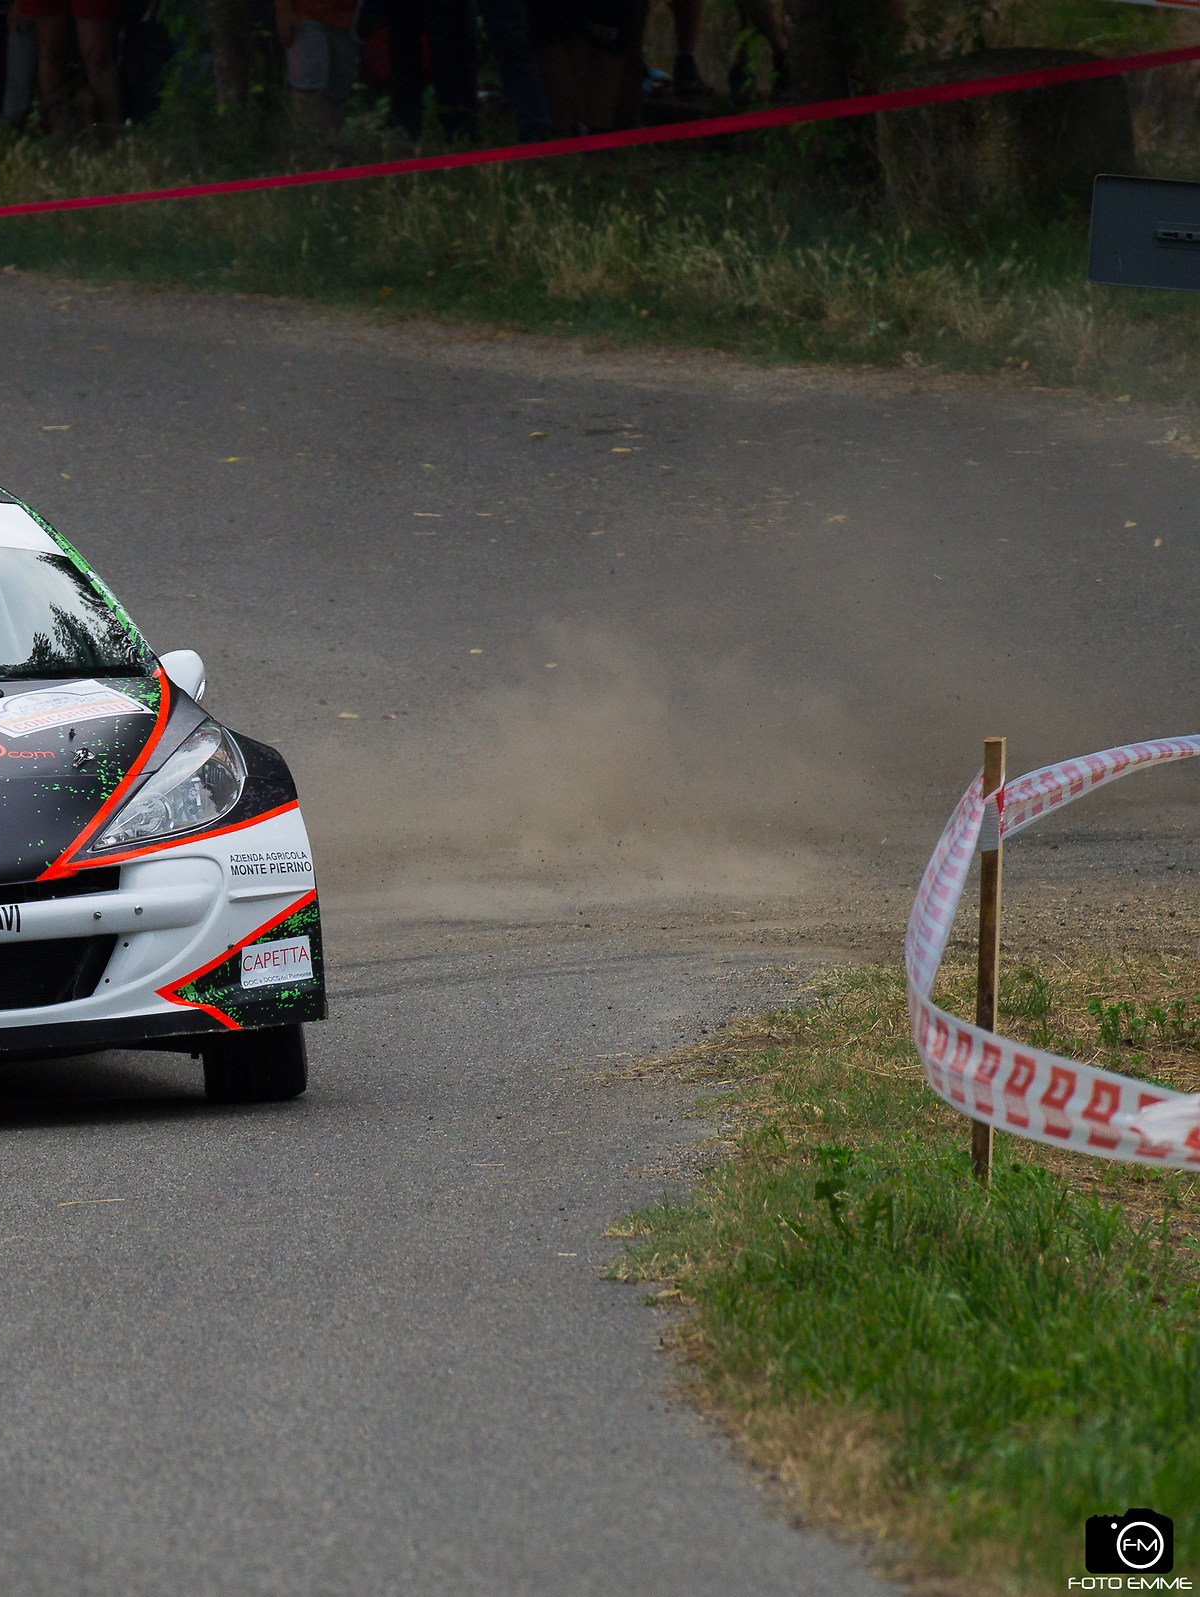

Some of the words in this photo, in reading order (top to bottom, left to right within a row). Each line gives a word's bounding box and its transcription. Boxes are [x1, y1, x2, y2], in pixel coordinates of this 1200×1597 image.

[13, 702, 135, 732] CONCORRENTE
[230, 853, 263, 863] AZIENDA
[265, 851, 308, 861] AGRICOLA
[230, 863, 268, 876] MONTE
[269, 861, 312, 874] PIERINO
[242, 945, 310, 972] CAPETTA
